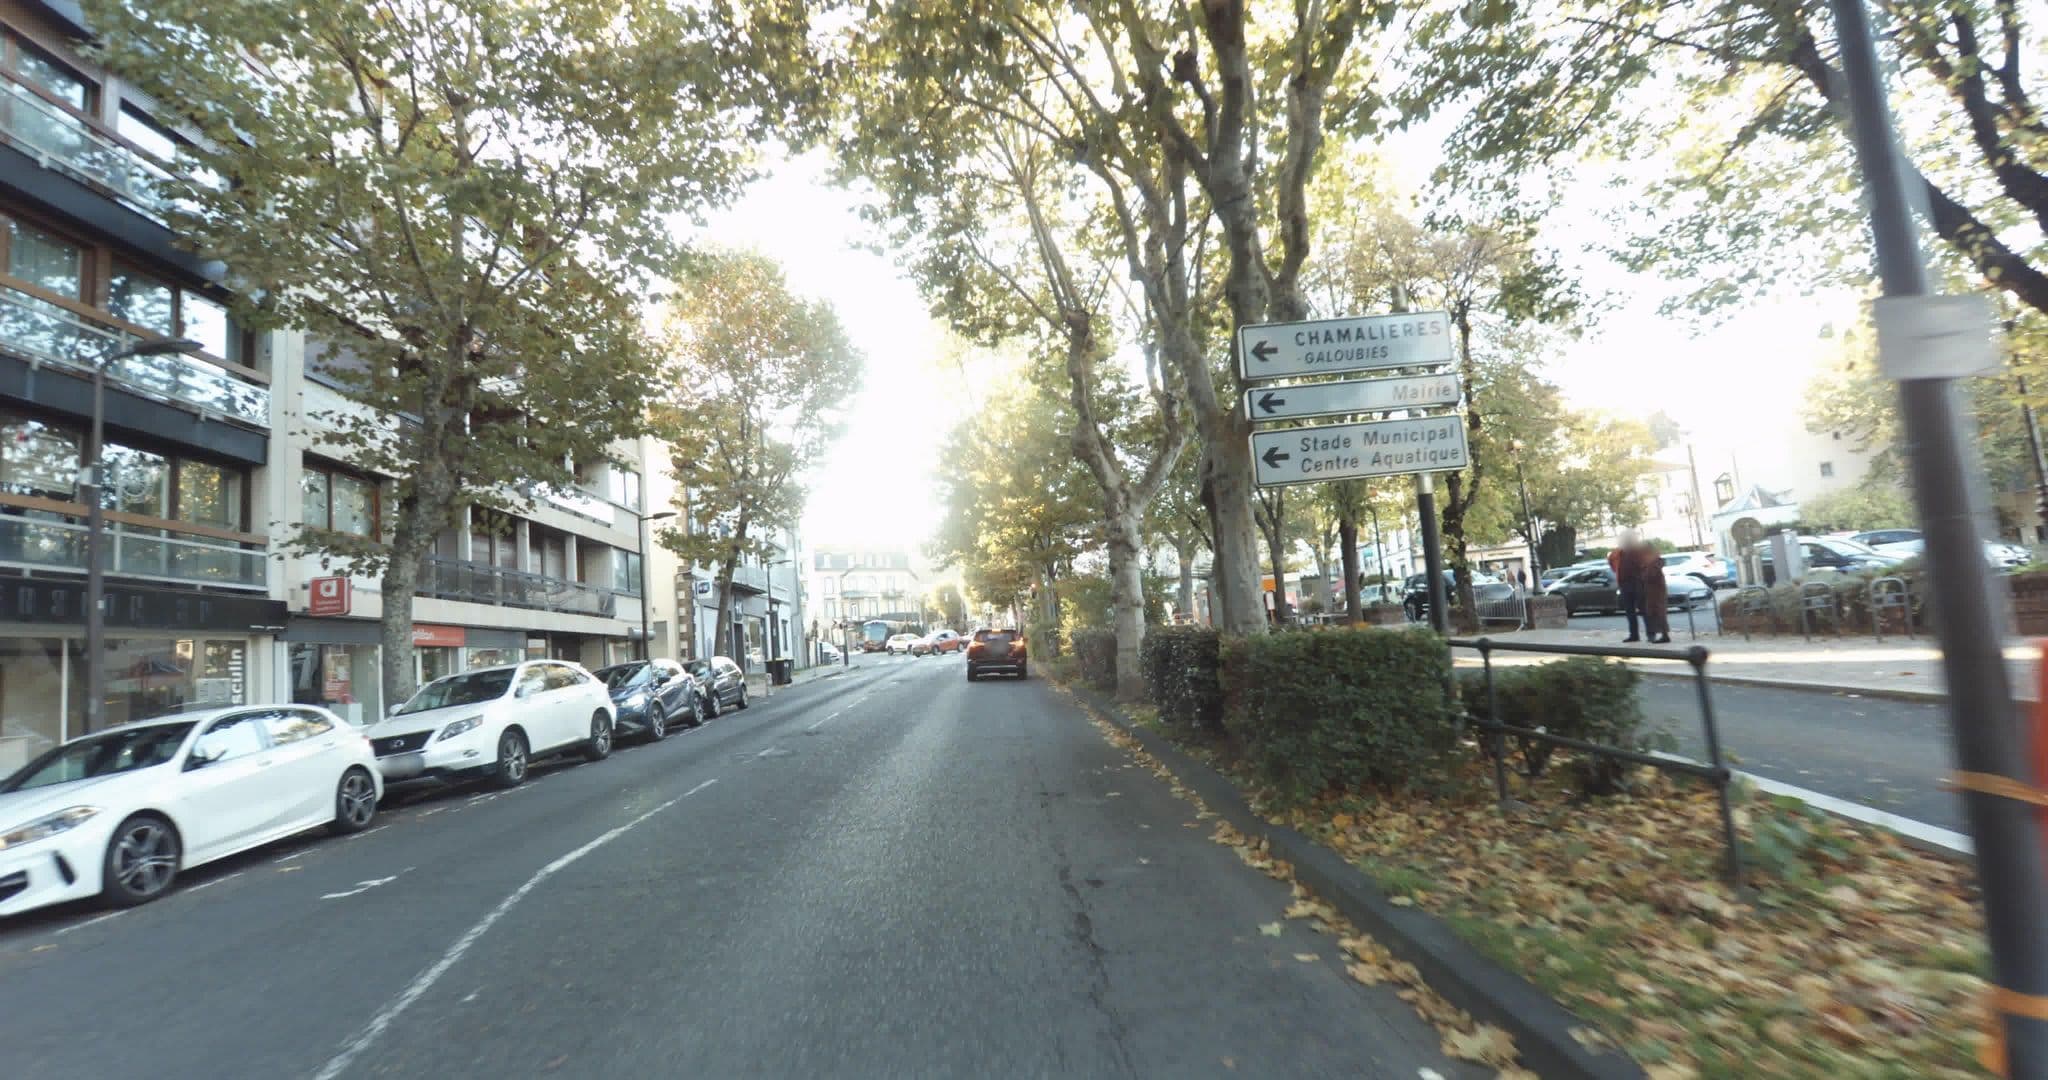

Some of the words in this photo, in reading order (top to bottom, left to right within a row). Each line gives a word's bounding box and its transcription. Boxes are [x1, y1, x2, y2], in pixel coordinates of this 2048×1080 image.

[1294, 320, 1442, 346] CHAMALIERES
[1304, 345, 1389, 364] GALOUBIES
[1392, 380, 1452, 401] Mairie
[1301, 434, 1352, 452] Stade
[1363, 423, 1455, 447] Municipal
[1301, 455, 1360, 474] Centre
[1371, 445, 1460, 469] Aquatique
